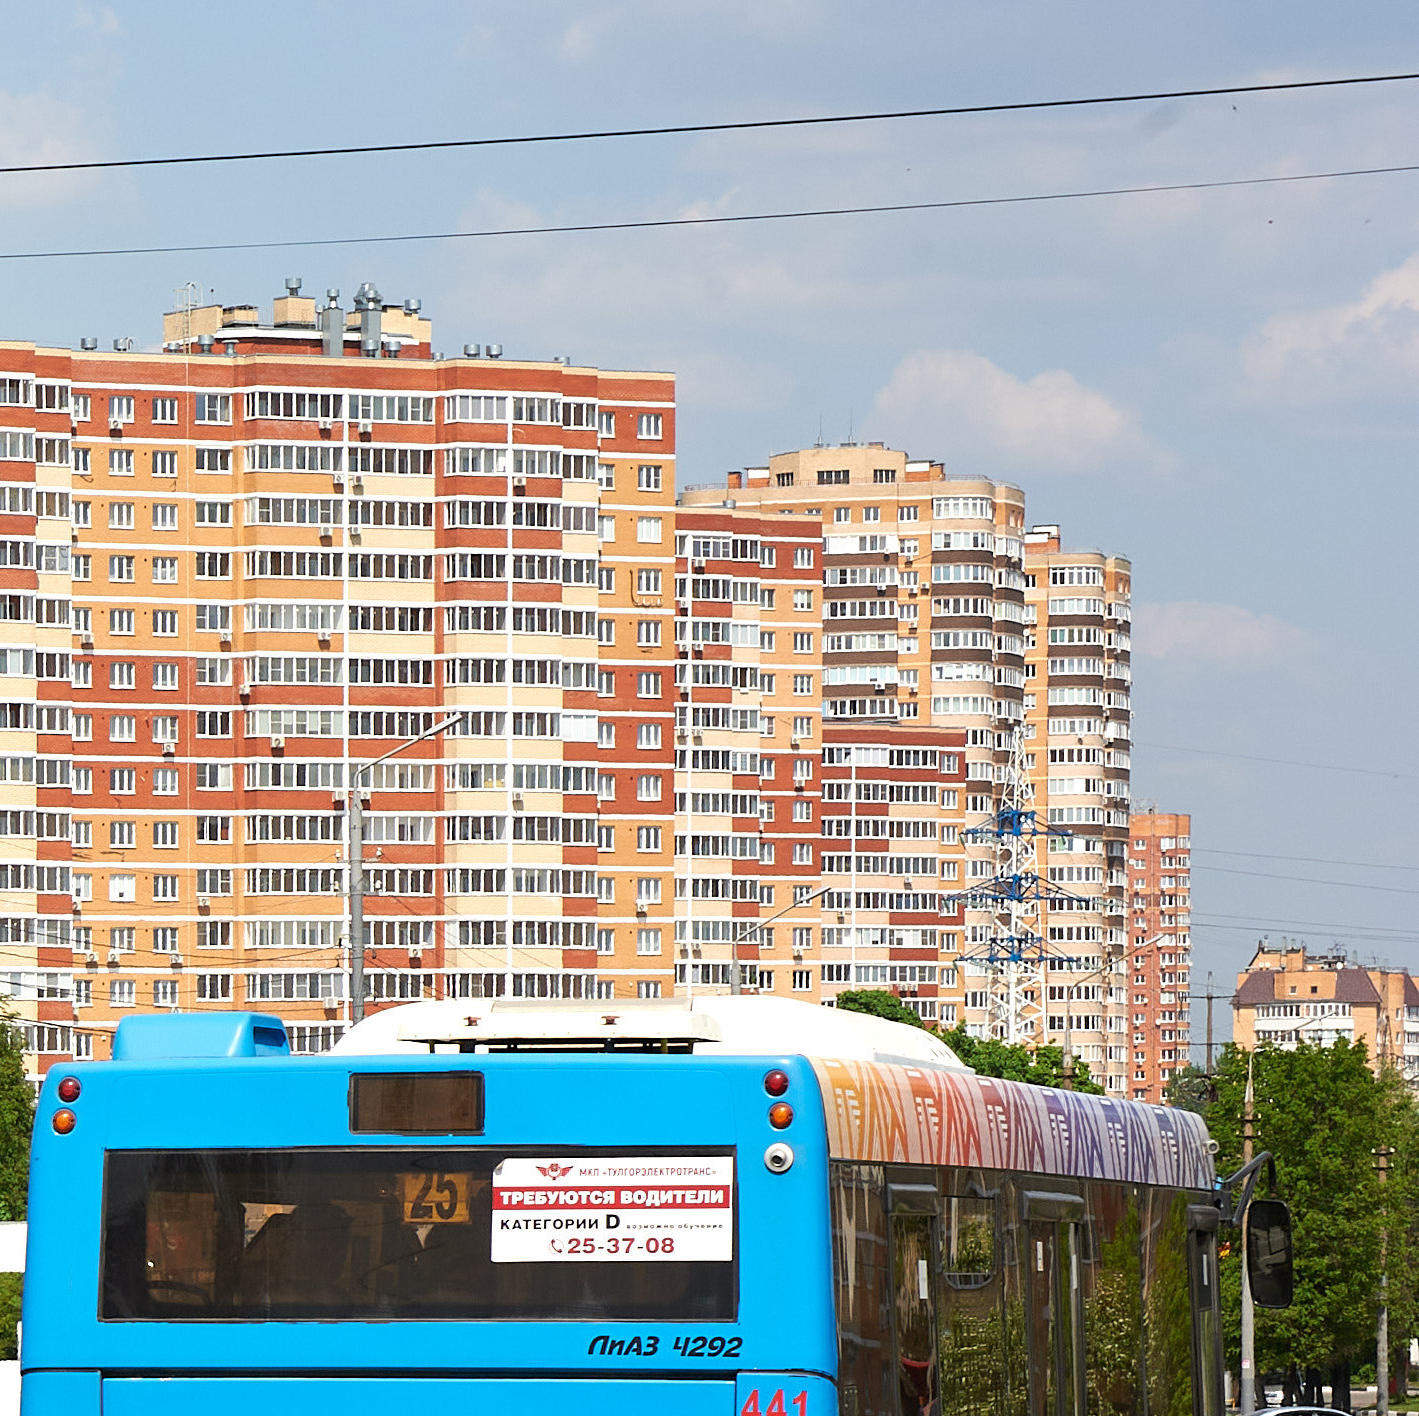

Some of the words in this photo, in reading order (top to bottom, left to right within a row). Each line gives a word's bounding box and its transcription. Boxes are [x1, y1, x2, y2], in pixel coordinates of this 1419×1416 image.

[579, 1168, 600, 1177] МКП
[411, 1173, 458, 1220] 25
[500, 1190, 616, 1206] ТРЕБУЮТСЯ
[620, 1189, 724, 1207] ВОДИТЕЛИ
[500, 1218, 599, 1231] КАТЕГОРИИ
[606, 1214, 621, 1229] D
[567, 1237, 675, 1254] 25-37-08
[587, 1335, 660, 1356] ЛиАЗ
[673, 1336, 743, 1358] 4292
